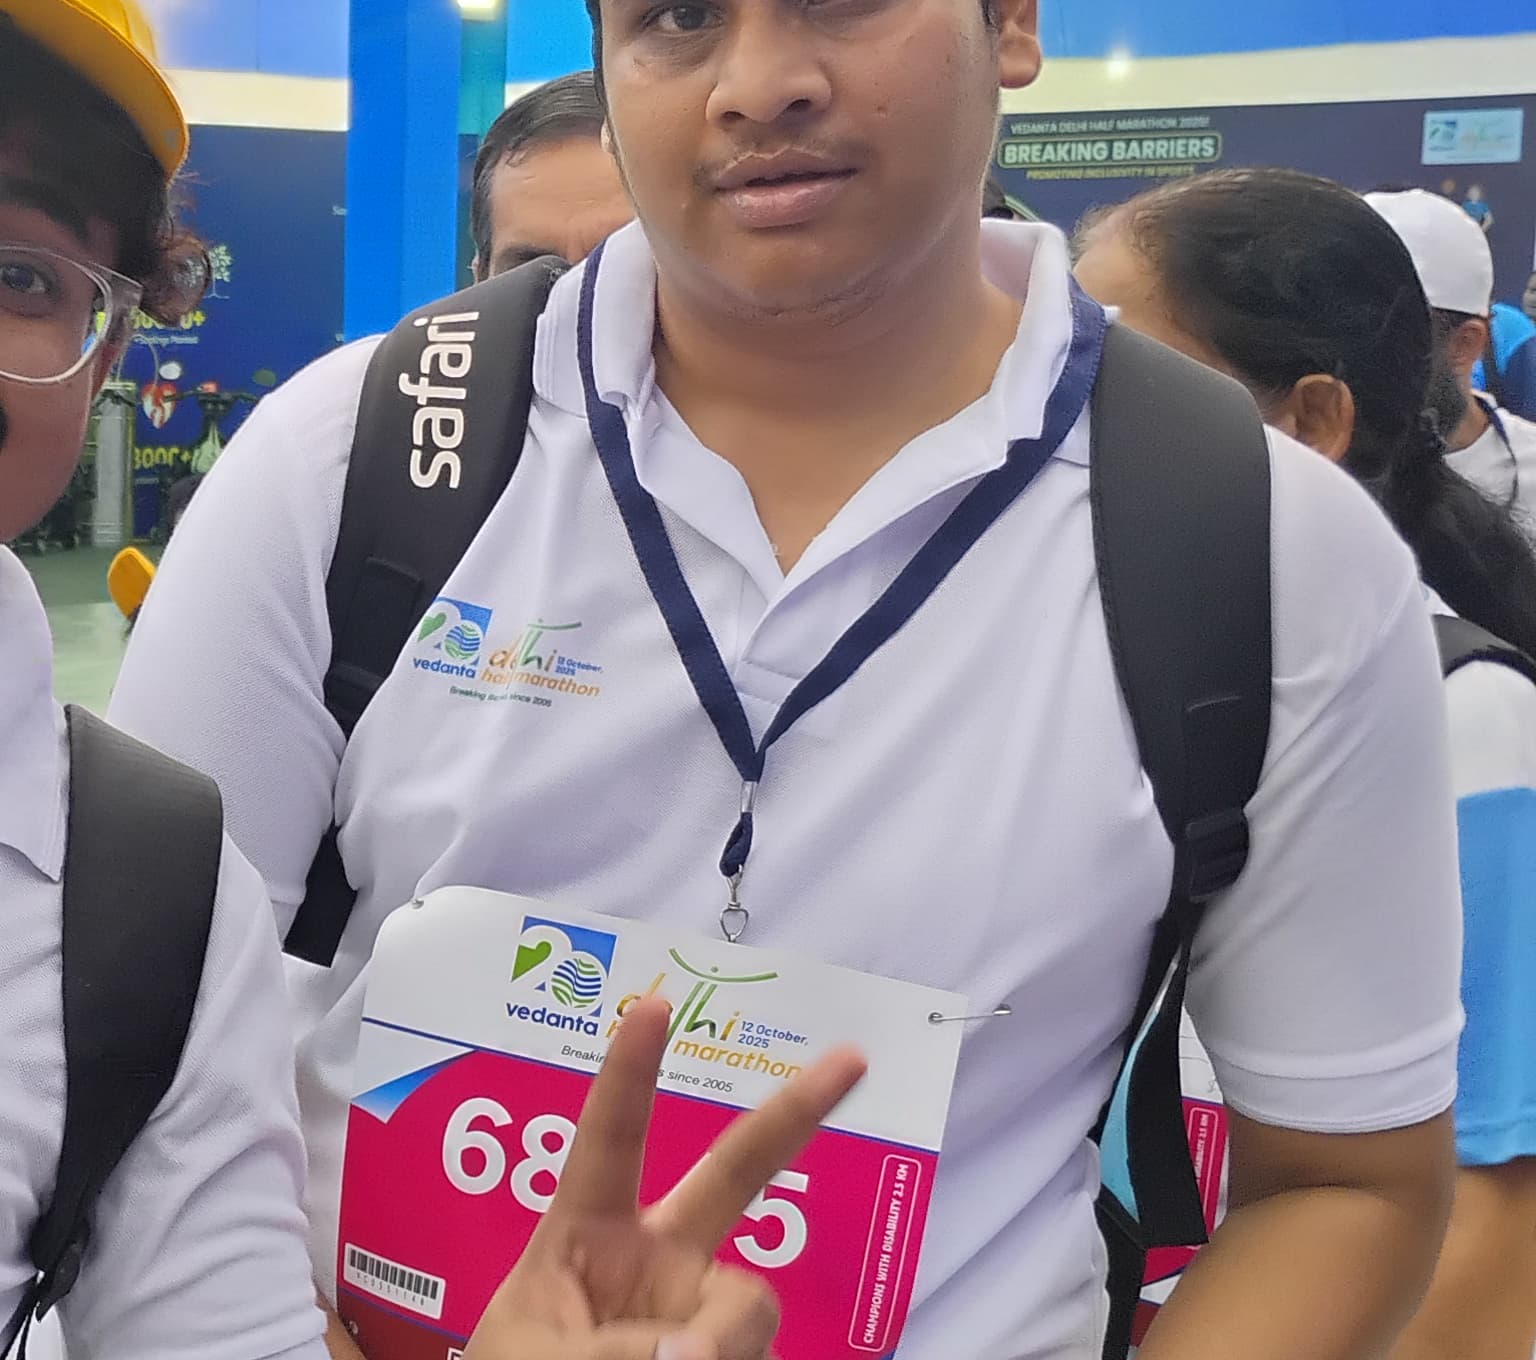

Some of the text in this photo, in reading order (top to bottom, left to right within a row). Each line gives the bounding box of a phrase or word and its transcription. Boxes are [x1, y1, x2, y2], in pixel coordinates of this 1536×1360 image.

[1004, 137, 1215, 164] BREAKING BARRIERS
[398, 311, 480, 490] safari
[413, 656, 477, 679] vedanta
[505, 1000, 599, 1037] vedanta
[737, 1033, 770, 1049] 2025
[740, 1019, 808, 1046] 12 October,
[666, 1069, 699, 1086] since
[701, 1075, 734, 1093] 2005
[442, 1096, 809, 1269] 685
[895, 1163, 909, 1182] KM
[881, 1197, 902, 1253] DISABILITY
[875, 1254, 891, 1282] WITH
[863, 1282, 887, 1345] CHAMPIONS
